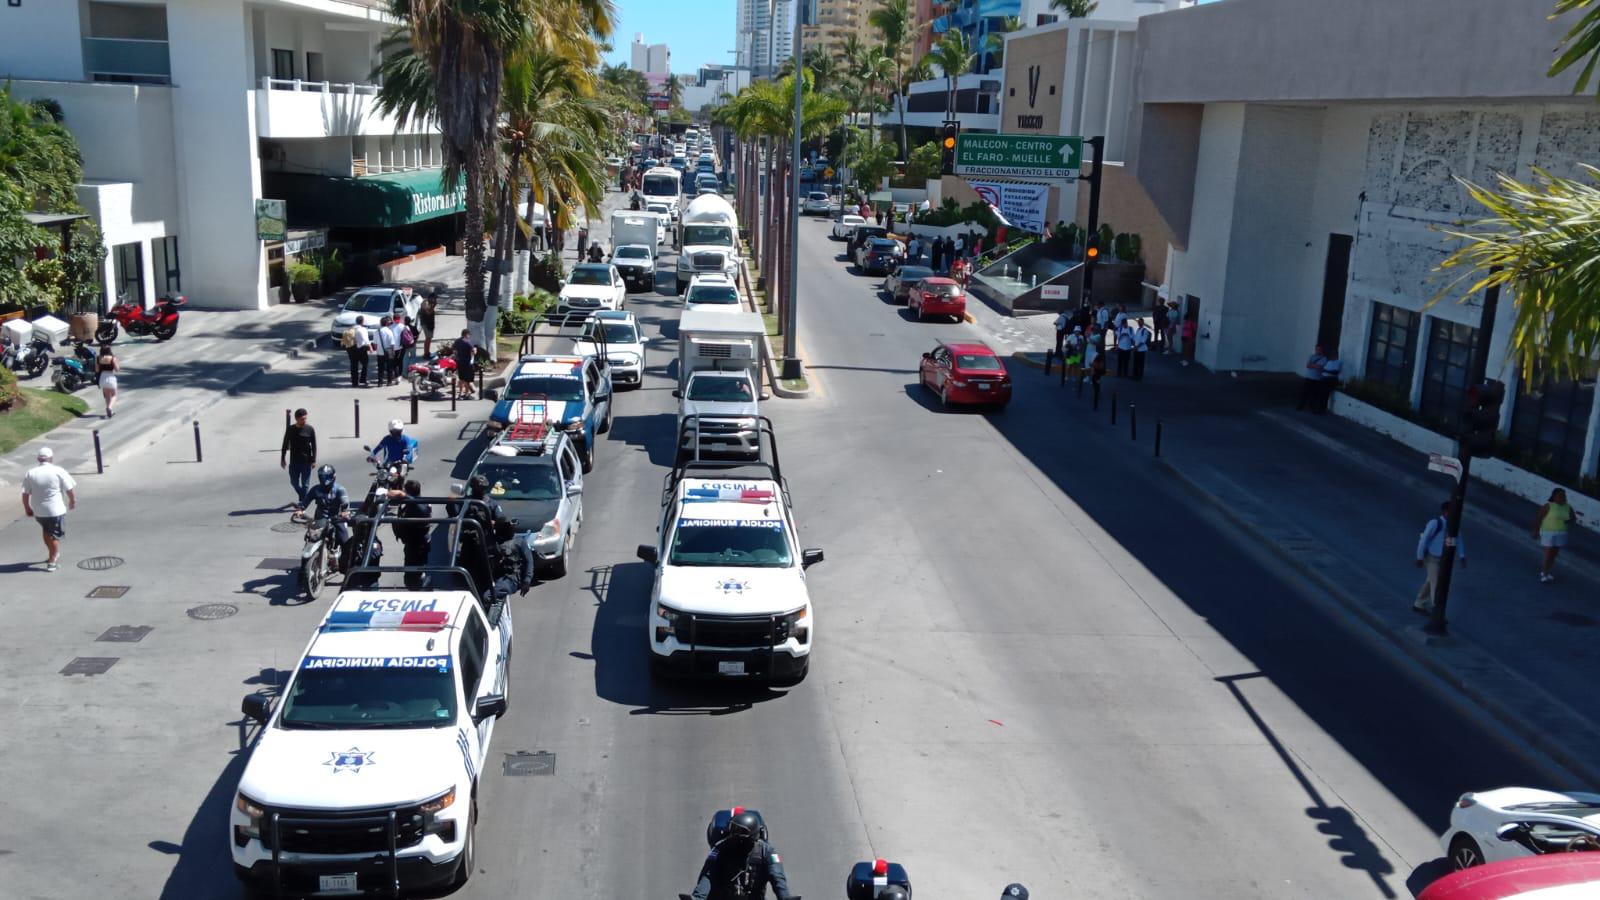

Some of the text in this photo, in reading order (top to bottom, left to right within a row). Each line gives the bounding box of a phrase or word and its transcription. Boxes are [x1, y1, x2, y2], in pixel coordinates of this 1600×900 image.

[963, 139, 1008, 149] MALECON
[1015, 141, 1053, 151] CENTRO
[962, 152, 974, 161] EL
[977, 152, 1003, 162] FARO
[1011, 154, 1052, 163] MUELLE
[965, 166, 1041, 176] FRACCIONAMIENTO
